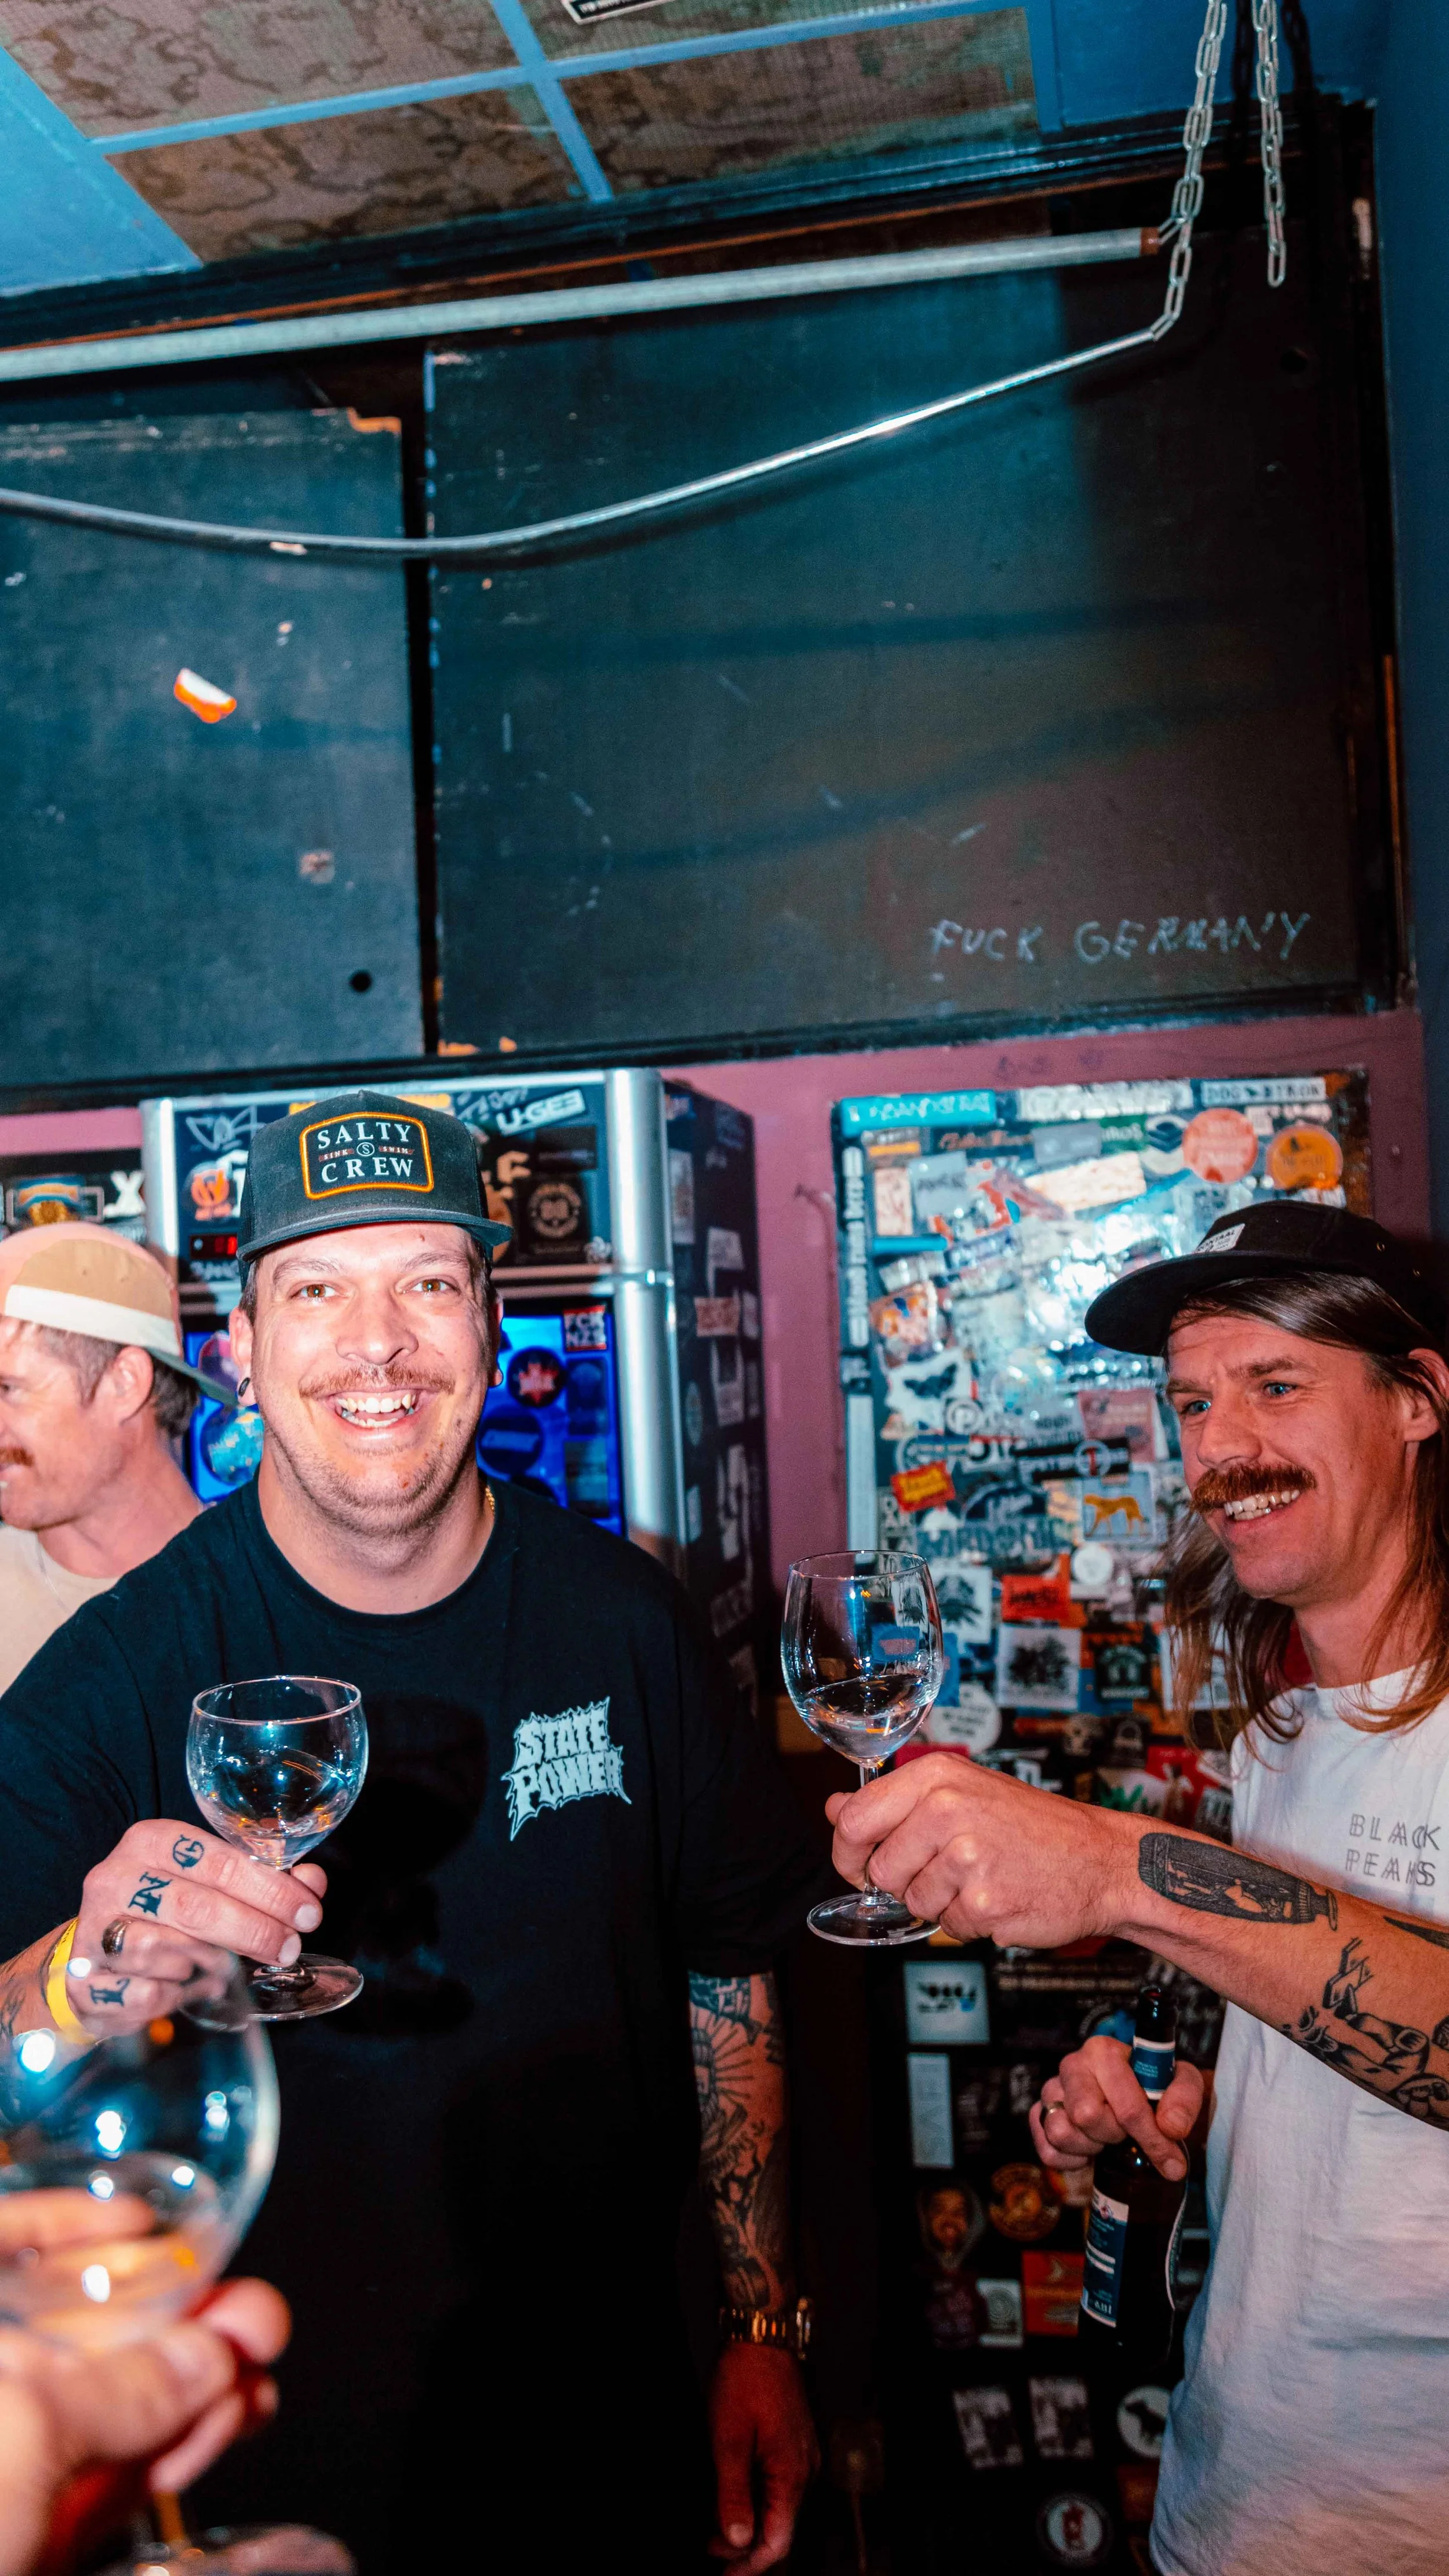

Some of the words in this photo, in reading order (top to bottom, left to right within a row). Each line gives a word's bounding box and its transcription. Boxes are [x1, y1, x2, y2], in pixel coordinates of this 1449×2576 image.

[929, 919, 1042, 962] FUCK
[1073, 911, 1311, 963] GERMANY
[317, 1122, 411, 1149] SALTY
[323, 1149, 348, 1160] SINK
[383, 1145, 409, 1154] SWIM
[321, 1156, 413, 1183] CREW
[514, 1696, 610, 1773] STATE
[1349, 1813, 1441, 1851] BLACK
